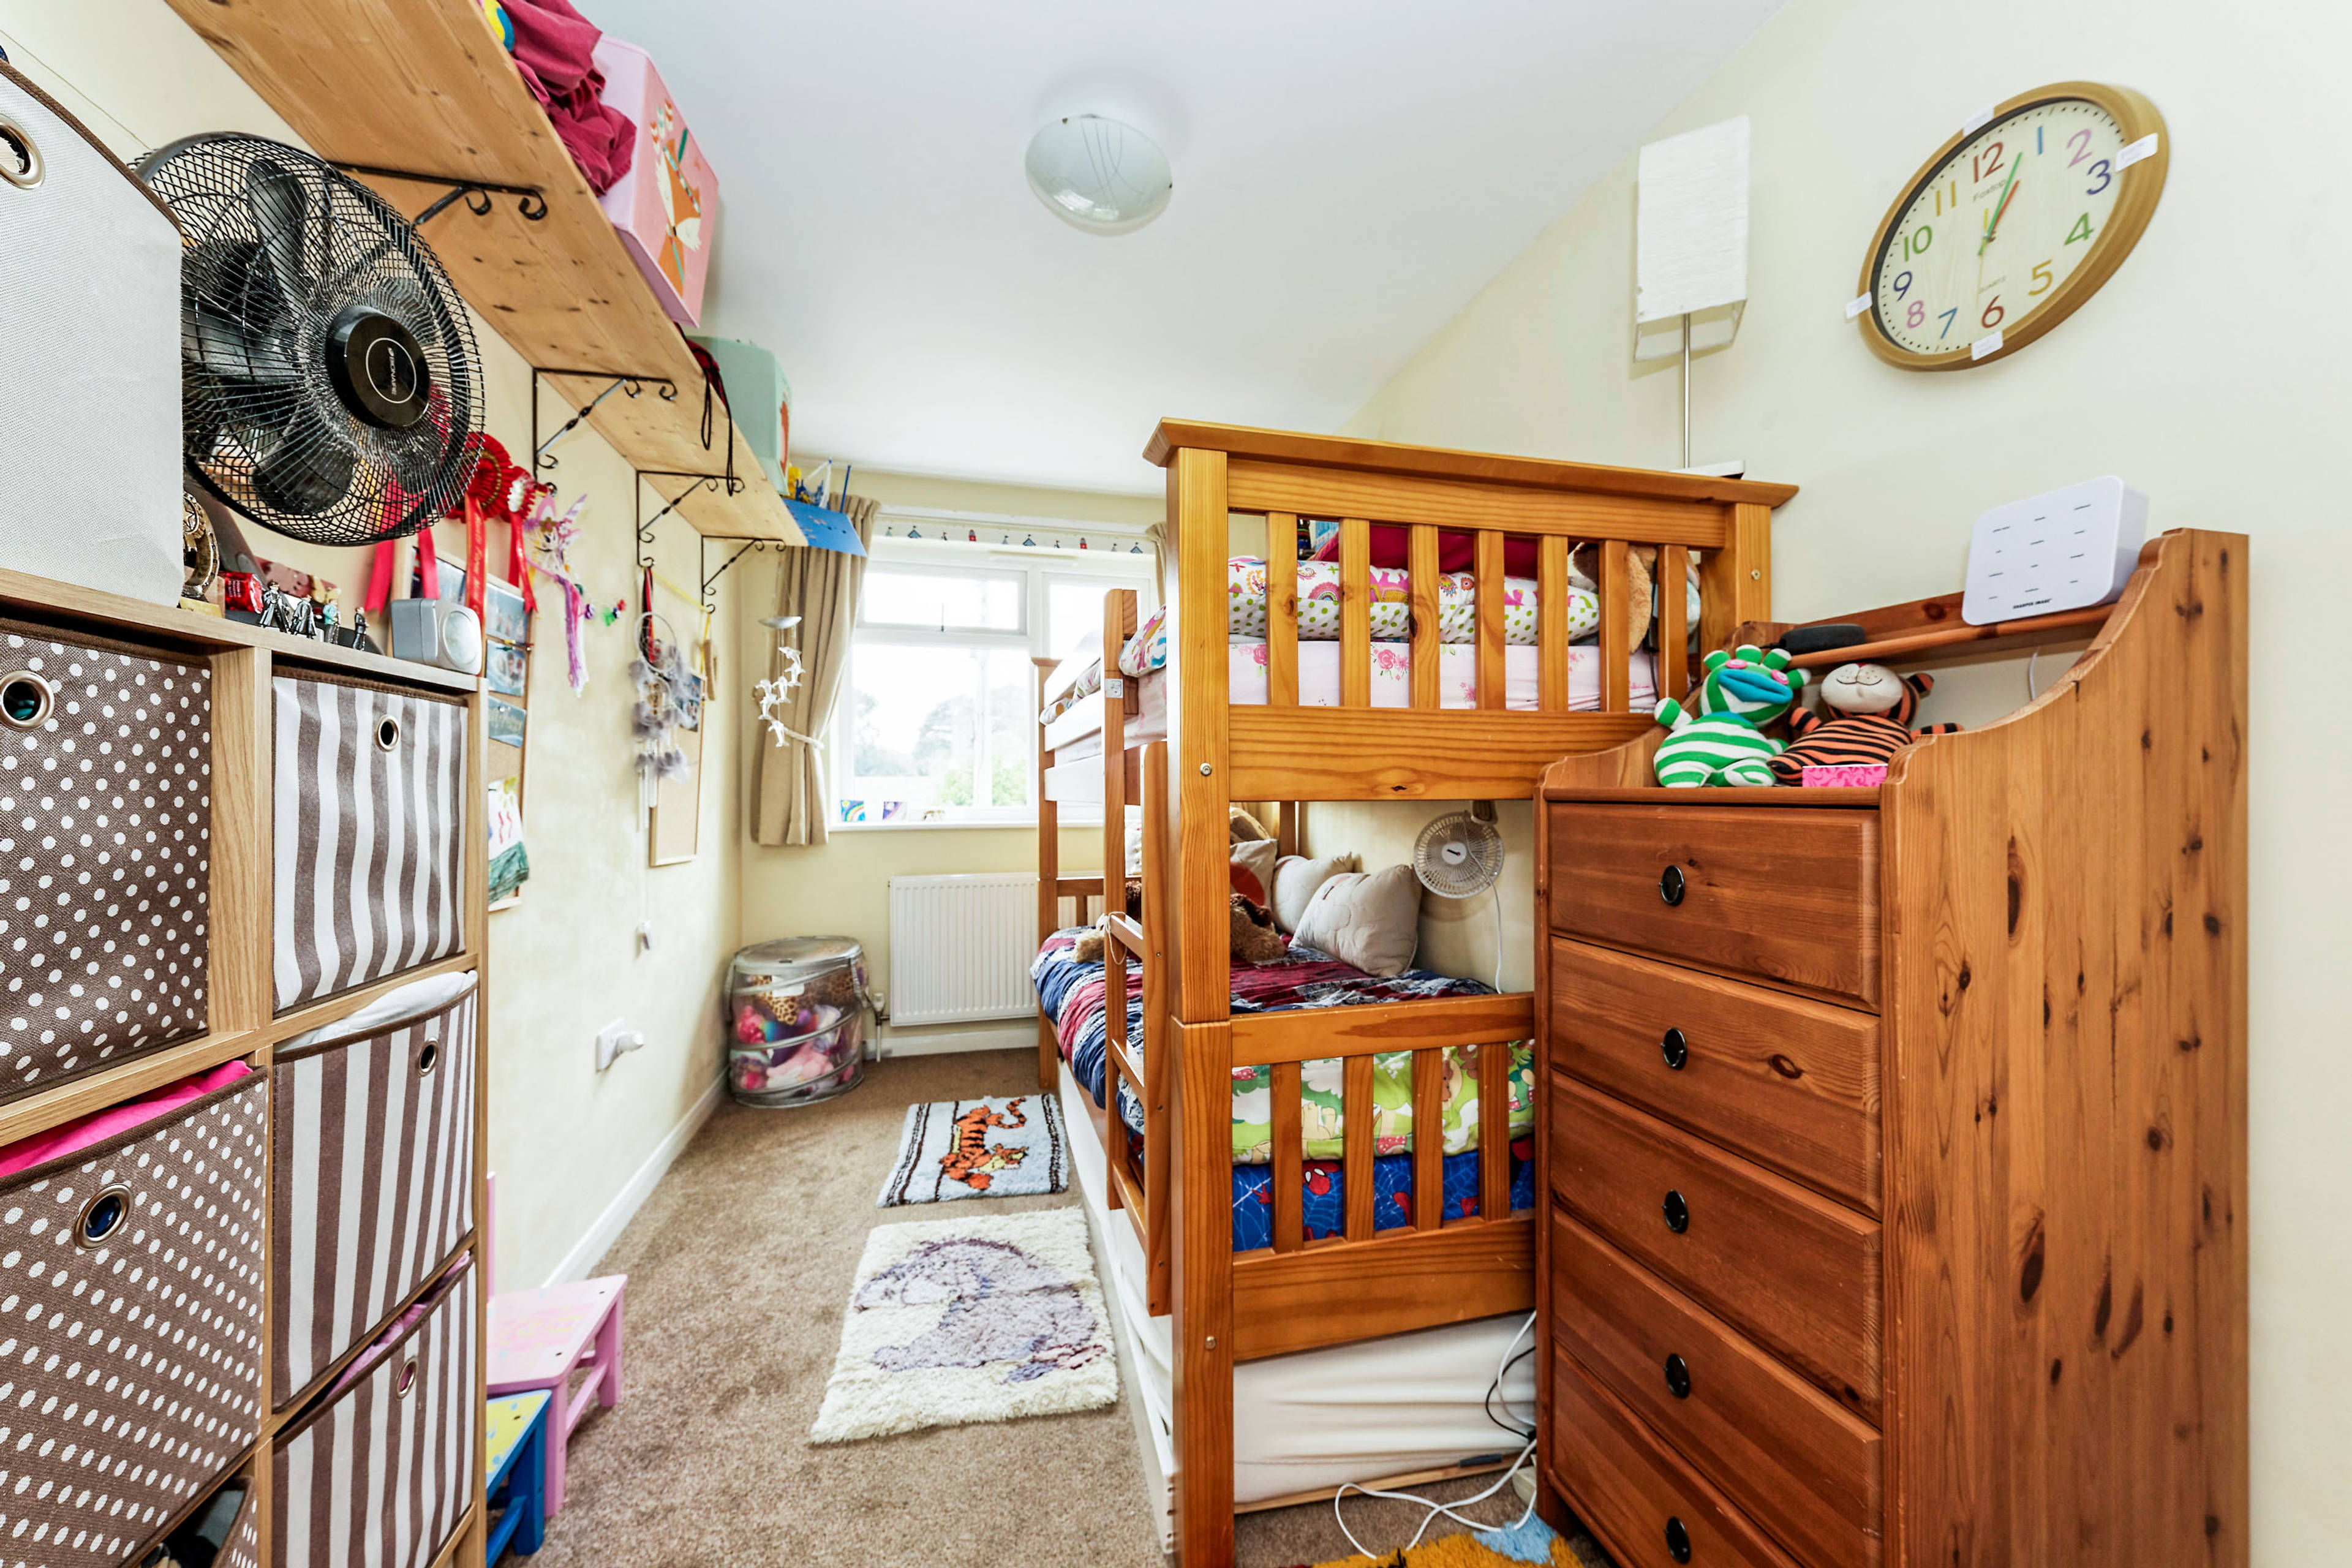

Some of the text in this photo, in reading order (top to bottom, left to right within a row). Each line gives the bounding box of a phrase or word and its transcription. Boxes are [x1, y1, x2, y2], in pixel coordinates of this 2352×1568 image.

[2038, 126, 2043, 156] 1
[2065, 129, 2093, 169] 2
[1973, 141, 2005, 184] 12
[2085, 159, 2112, 195] 3
[1936, 180, 1956, 217] 11
[1903, 225, 1932, 262] 10
[2064, 212, 2095, 246] 4
[1893, 271, 1913, 302] 9
[2027, 258, 2053, 296] 5
[1906, 300, 1925, 329] 8
[1937, 307, 1958, 340] 7
[1981, 295, 2004, 328] 6
